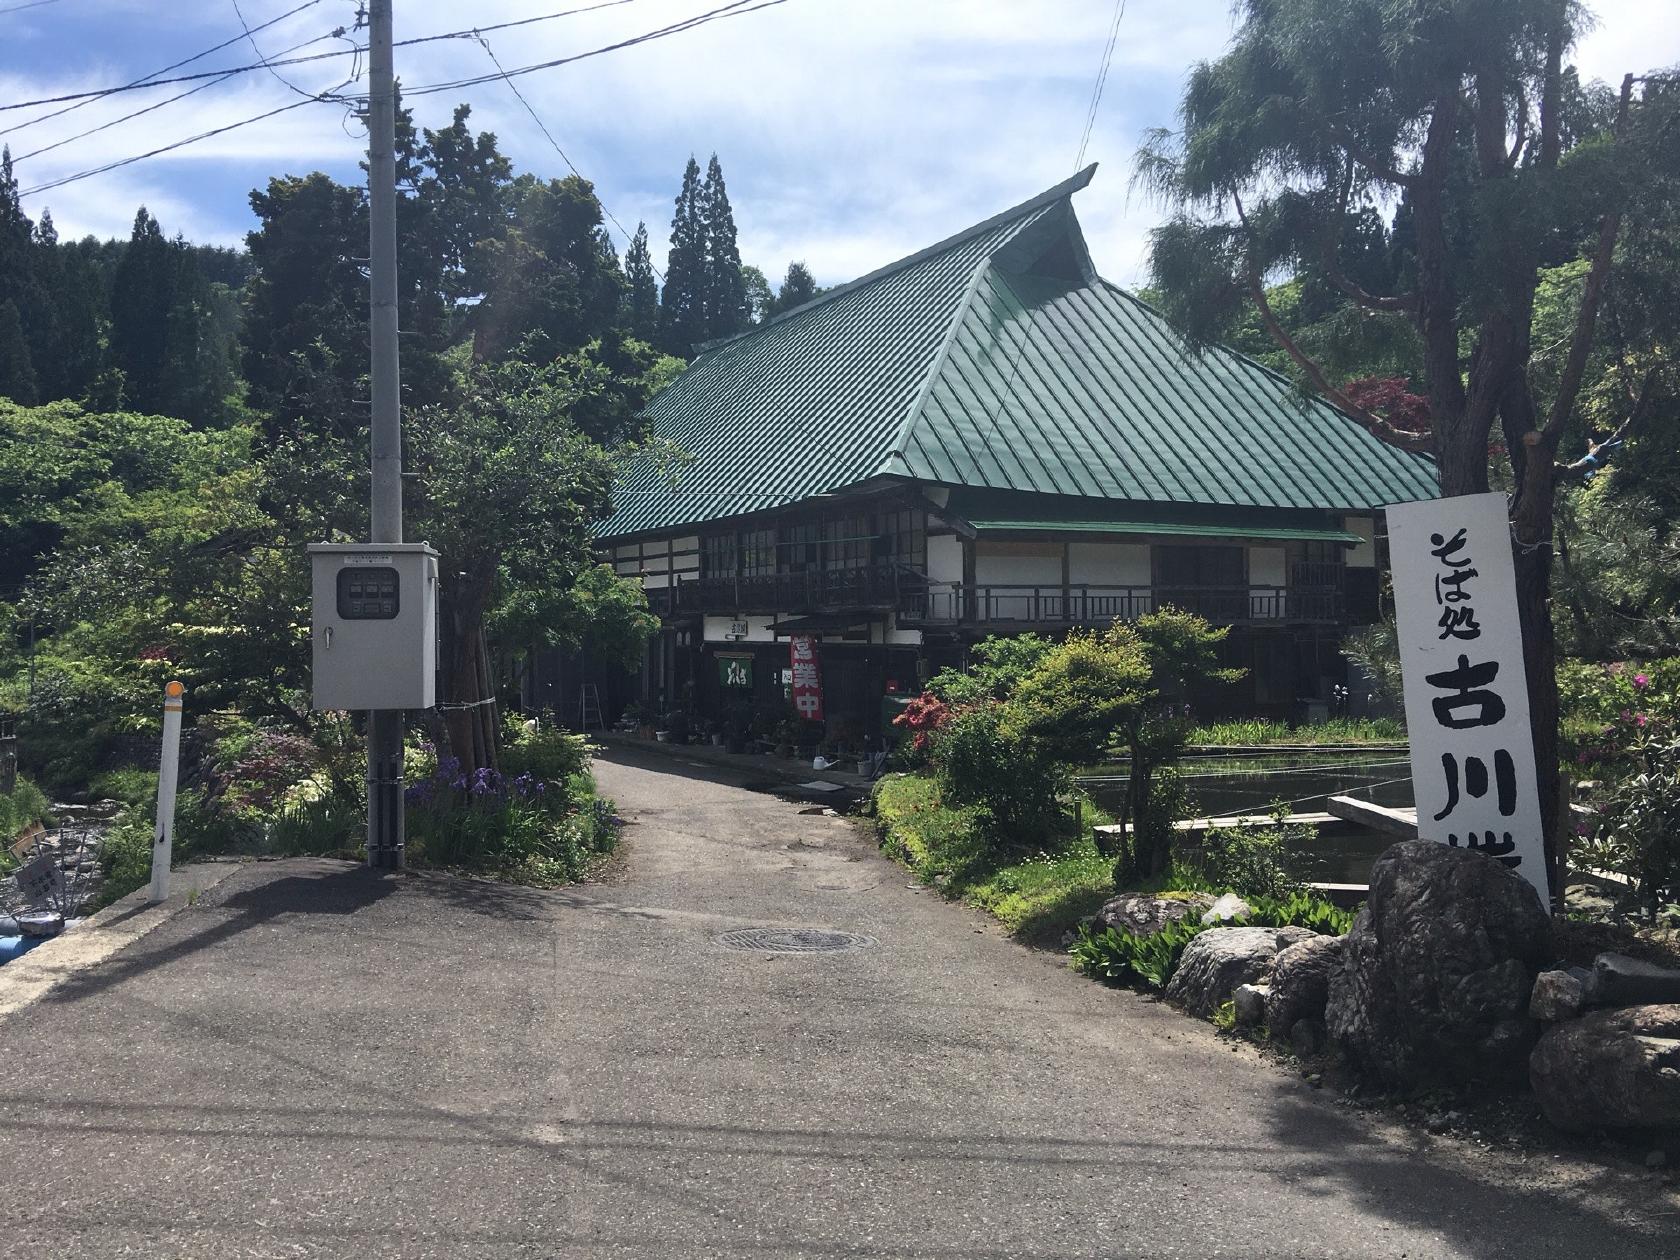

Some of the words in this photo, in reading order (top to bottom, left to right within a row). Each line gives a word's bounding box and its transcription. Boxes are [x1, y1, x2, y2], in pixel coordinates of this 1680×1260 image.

[1430, 528, 1481, 640] そば処
[793, 636, 819, 718] 営業中
